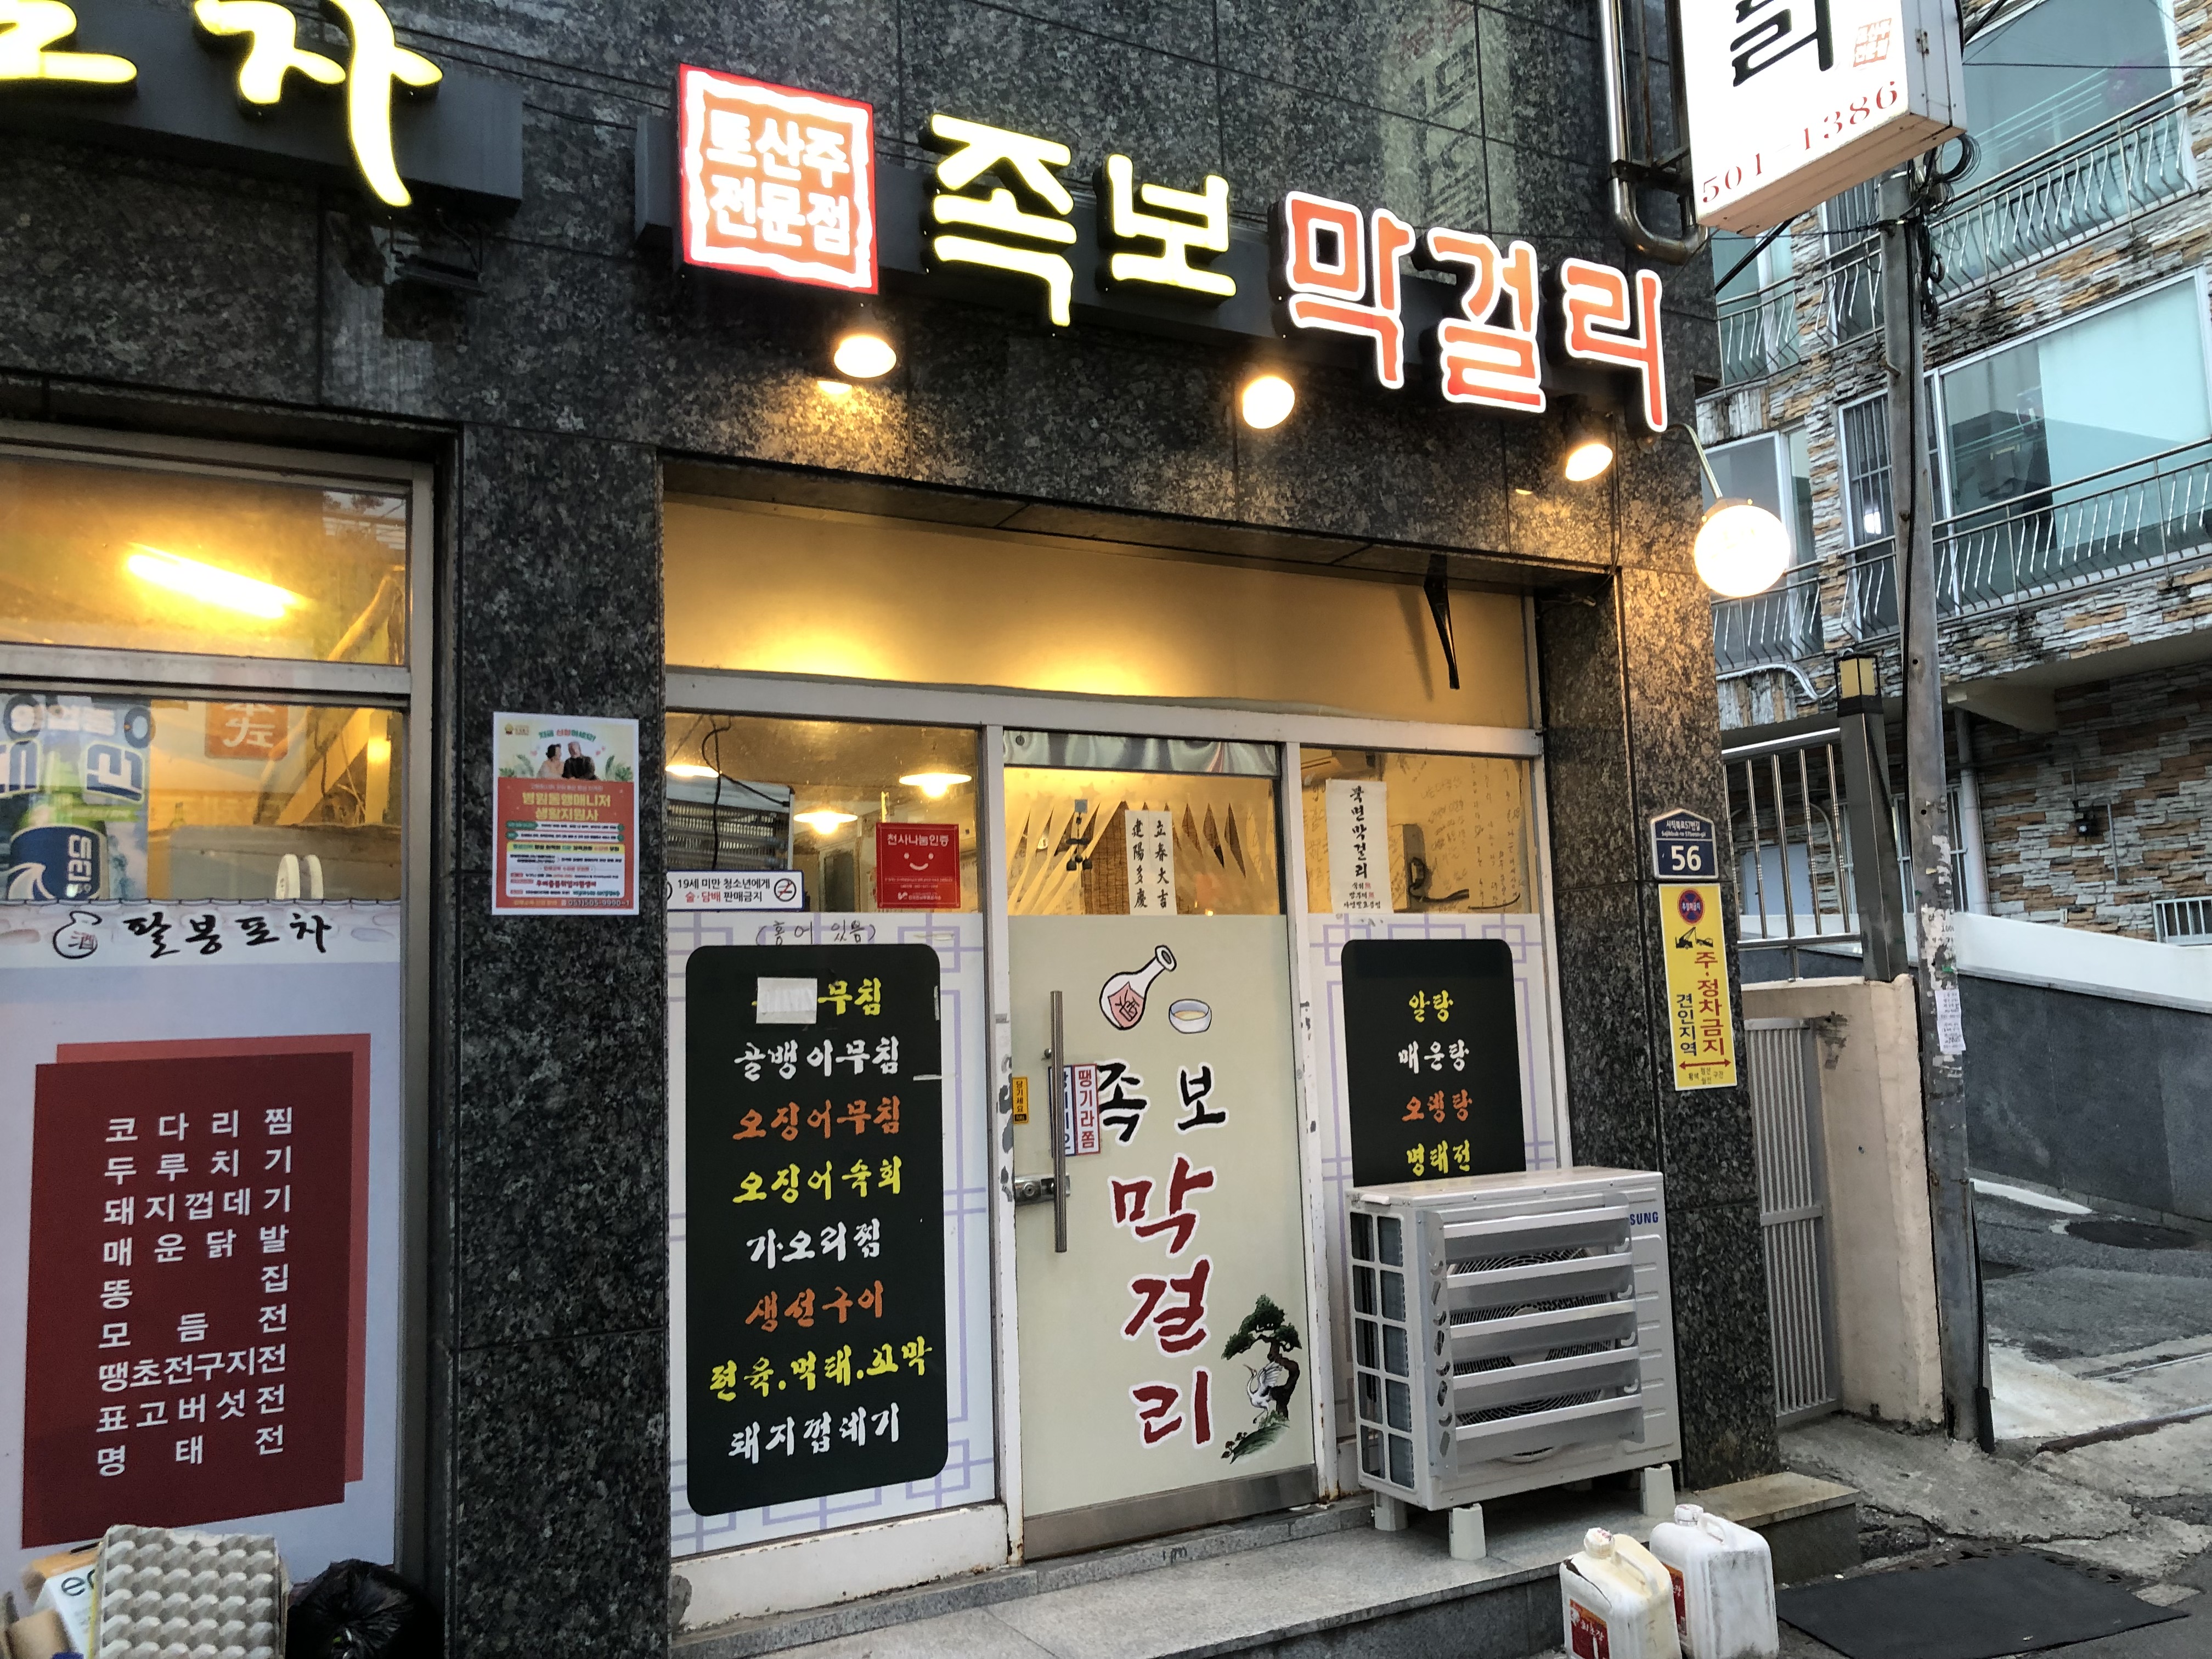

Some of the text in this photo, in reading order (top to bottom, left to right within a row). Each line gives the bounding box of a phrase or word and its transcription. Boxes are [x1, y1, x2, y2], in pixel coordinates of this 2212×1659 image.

[706, 109, 850, 188] 토산주
[1702, 81, 1898, 204] 501-1386
[709, 173, 850, 256] 전문점
[932, 114, 1237, 327] 족보
[1285, 190, 1668, 432] 막걸리
[887, 833, 949, 847] 천사나눔인증
[1131, 818, 1148, 909] 建陽多慶
[1671, 845, 1701, 872] 56
[678, 878, 770, 889] 19세 미만 청소년에게
[1154, 820, 1169, 909] 立春大吉
[724, 891, 762, 902] 판매금지
[68, 932, 97, 951] 酒
[122, 911, 332, 959] 팔봉포차
[1408, 990, 1454, 1023] 알탕
[1676, 992, 1697, 1057] 견인지역
[734, 1035, 900, 1082] 골뱅이무침
[1398, 1039, 1470, 1074] 매운탕
[105, 1107, 292, 1143] 코다리찜
[732, 1095, 901, 1142] 오징어무침
[1079, 1069, 1096, 1149] 땡기라쫌
[1097, 1063, 1227, 1143] 족보
[104, 1146, 292, 1185] 두루치기
[732, 1155, 902, 1204] 오징어숙회
[1407, 1139, 1471, 1177] 명태전
[103, 1184, 291, 1226] 돼지껍데기
[103, 1224, 289, 1267] 매운닭발
[746, 1218, 881, 1269] 가오리찜
[100, 1263, 289, 1310] 똥집
[745, 1280, 884, 1333] 생선구이
[1111, 1157, 1215, 1445] 막걸리
[96, 1384, 285, 1433] 표고버섯전
[97, 1425, 284, 1476] 명태전
[728, 1402, 900, 1464] 돼지껍데기
